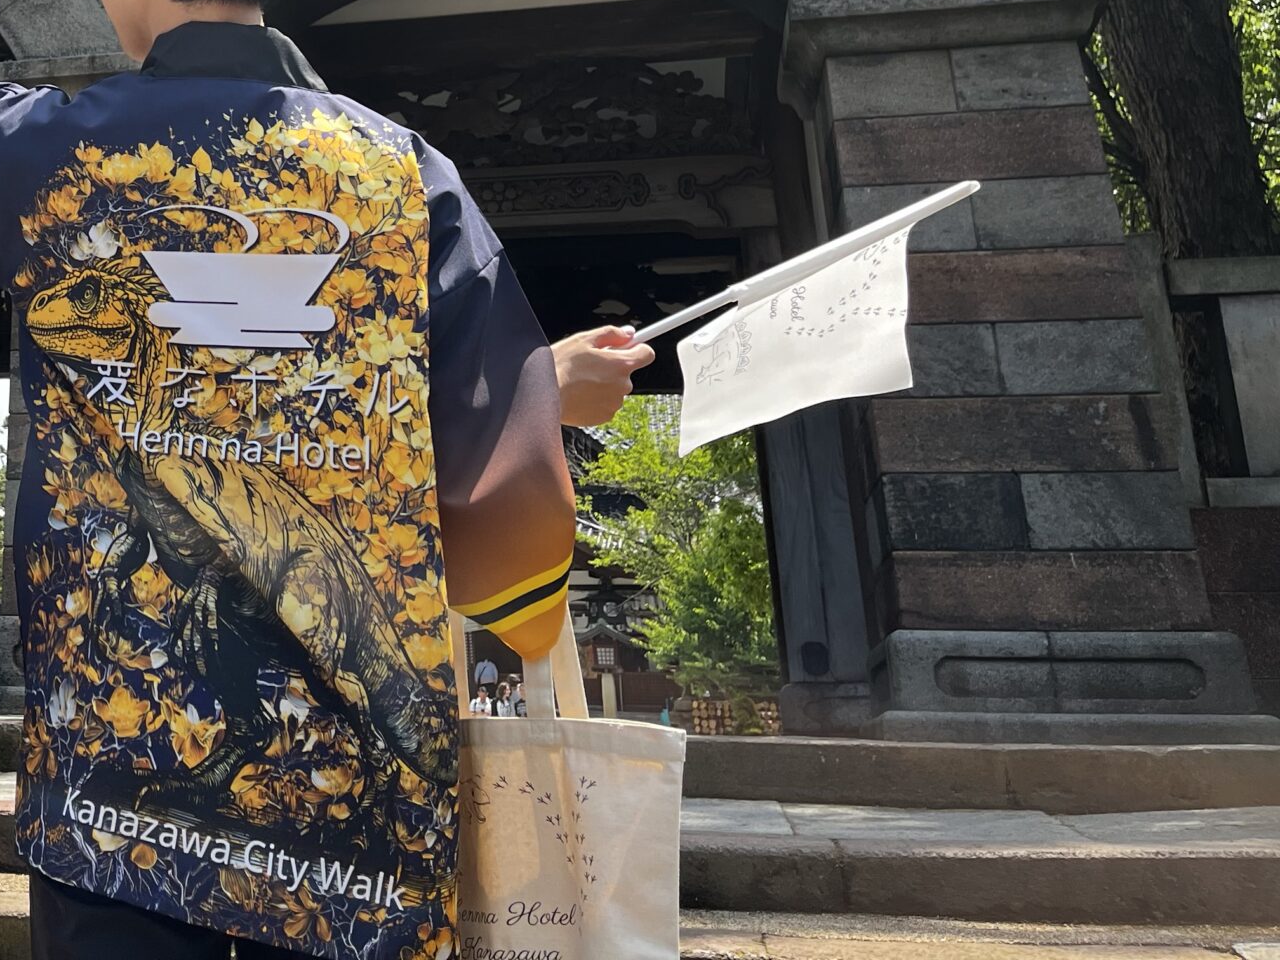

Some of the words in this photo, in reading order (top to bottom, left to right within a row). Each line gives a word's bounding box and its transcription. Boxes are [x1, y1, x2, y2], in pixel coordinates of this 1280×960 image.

[791, 286, 806, 321] Hotel
[87, 358, 410, 417] 変なホテル
[118, 419, 208, 458] Henn
[220, 438, 263, 463] na
[275, 433, 371, 471] Hotel
[62, 788, 231, 866] Kanazawa
[244, 843, 309, 892] City
[319, 857, 404, 912] Walk
[506, 901, 577, 926] Hotel
